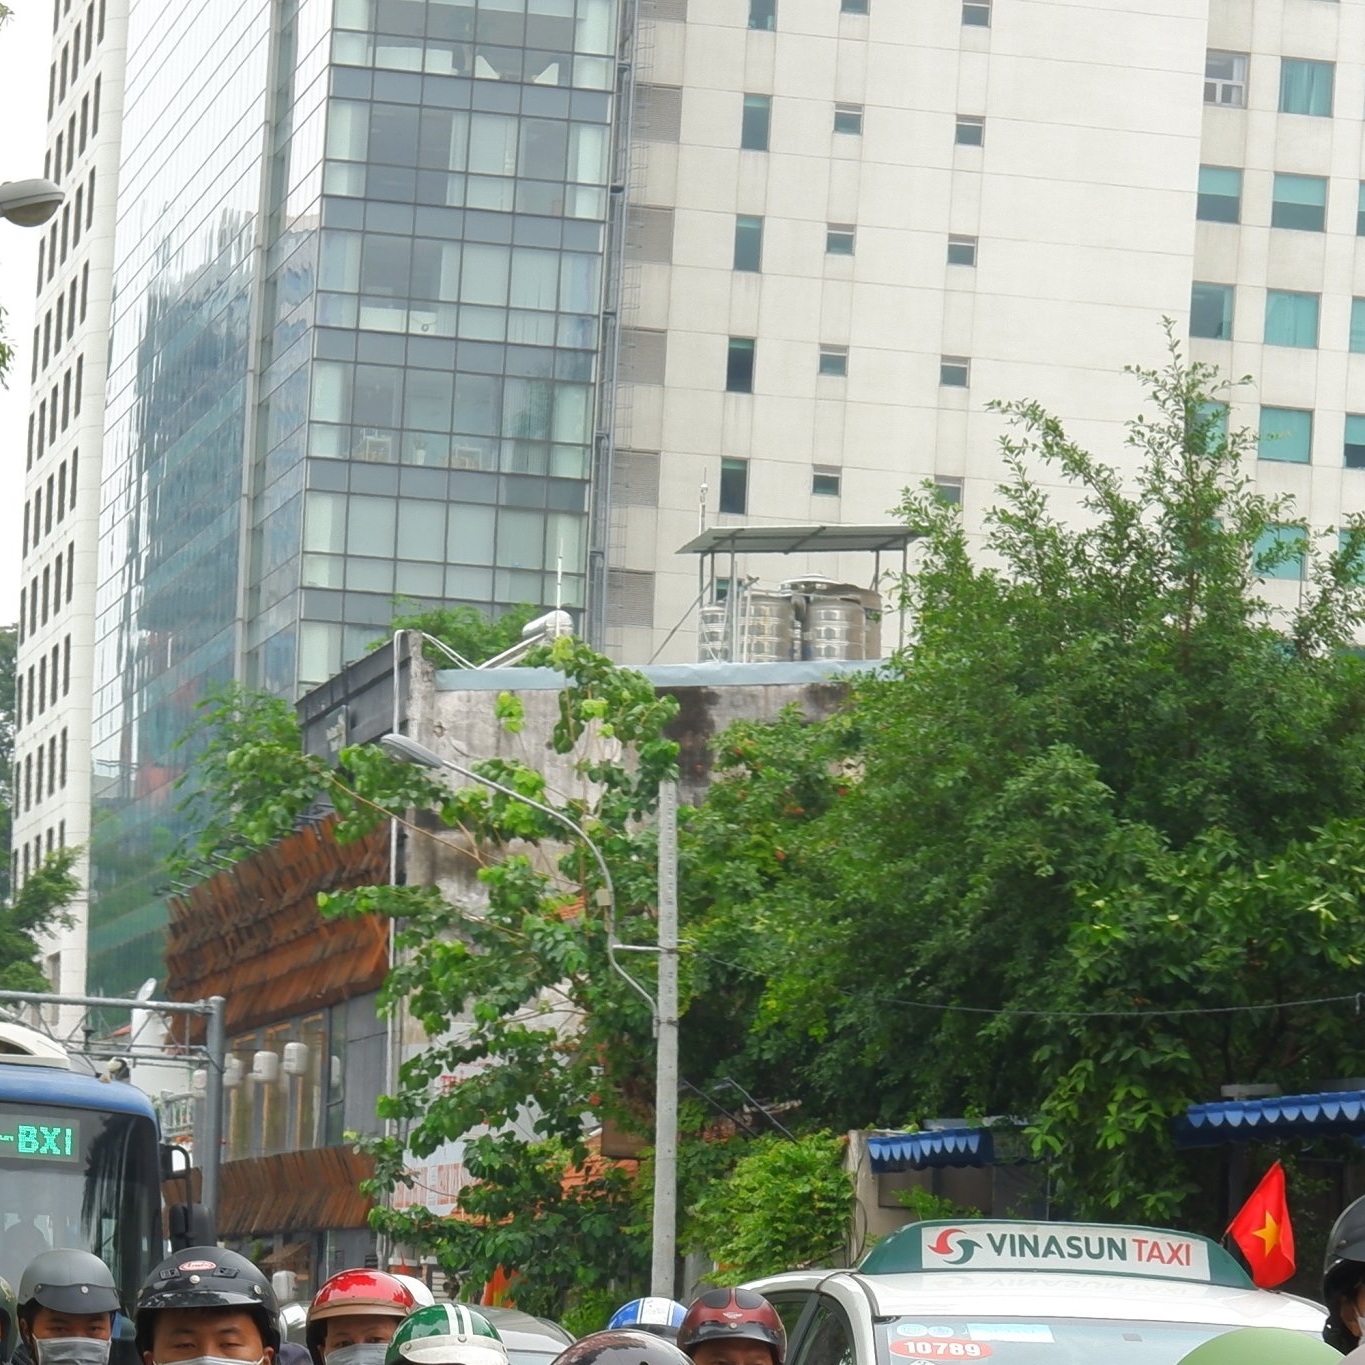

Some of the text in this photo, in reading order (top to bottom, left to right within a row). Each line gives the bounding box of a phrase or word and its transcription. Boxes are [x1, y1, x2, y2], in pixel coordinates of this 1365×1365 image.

[985, 1231, 1193, 1267] VINASUN TAXI
[903, 1341, 982, 1357] 10789
